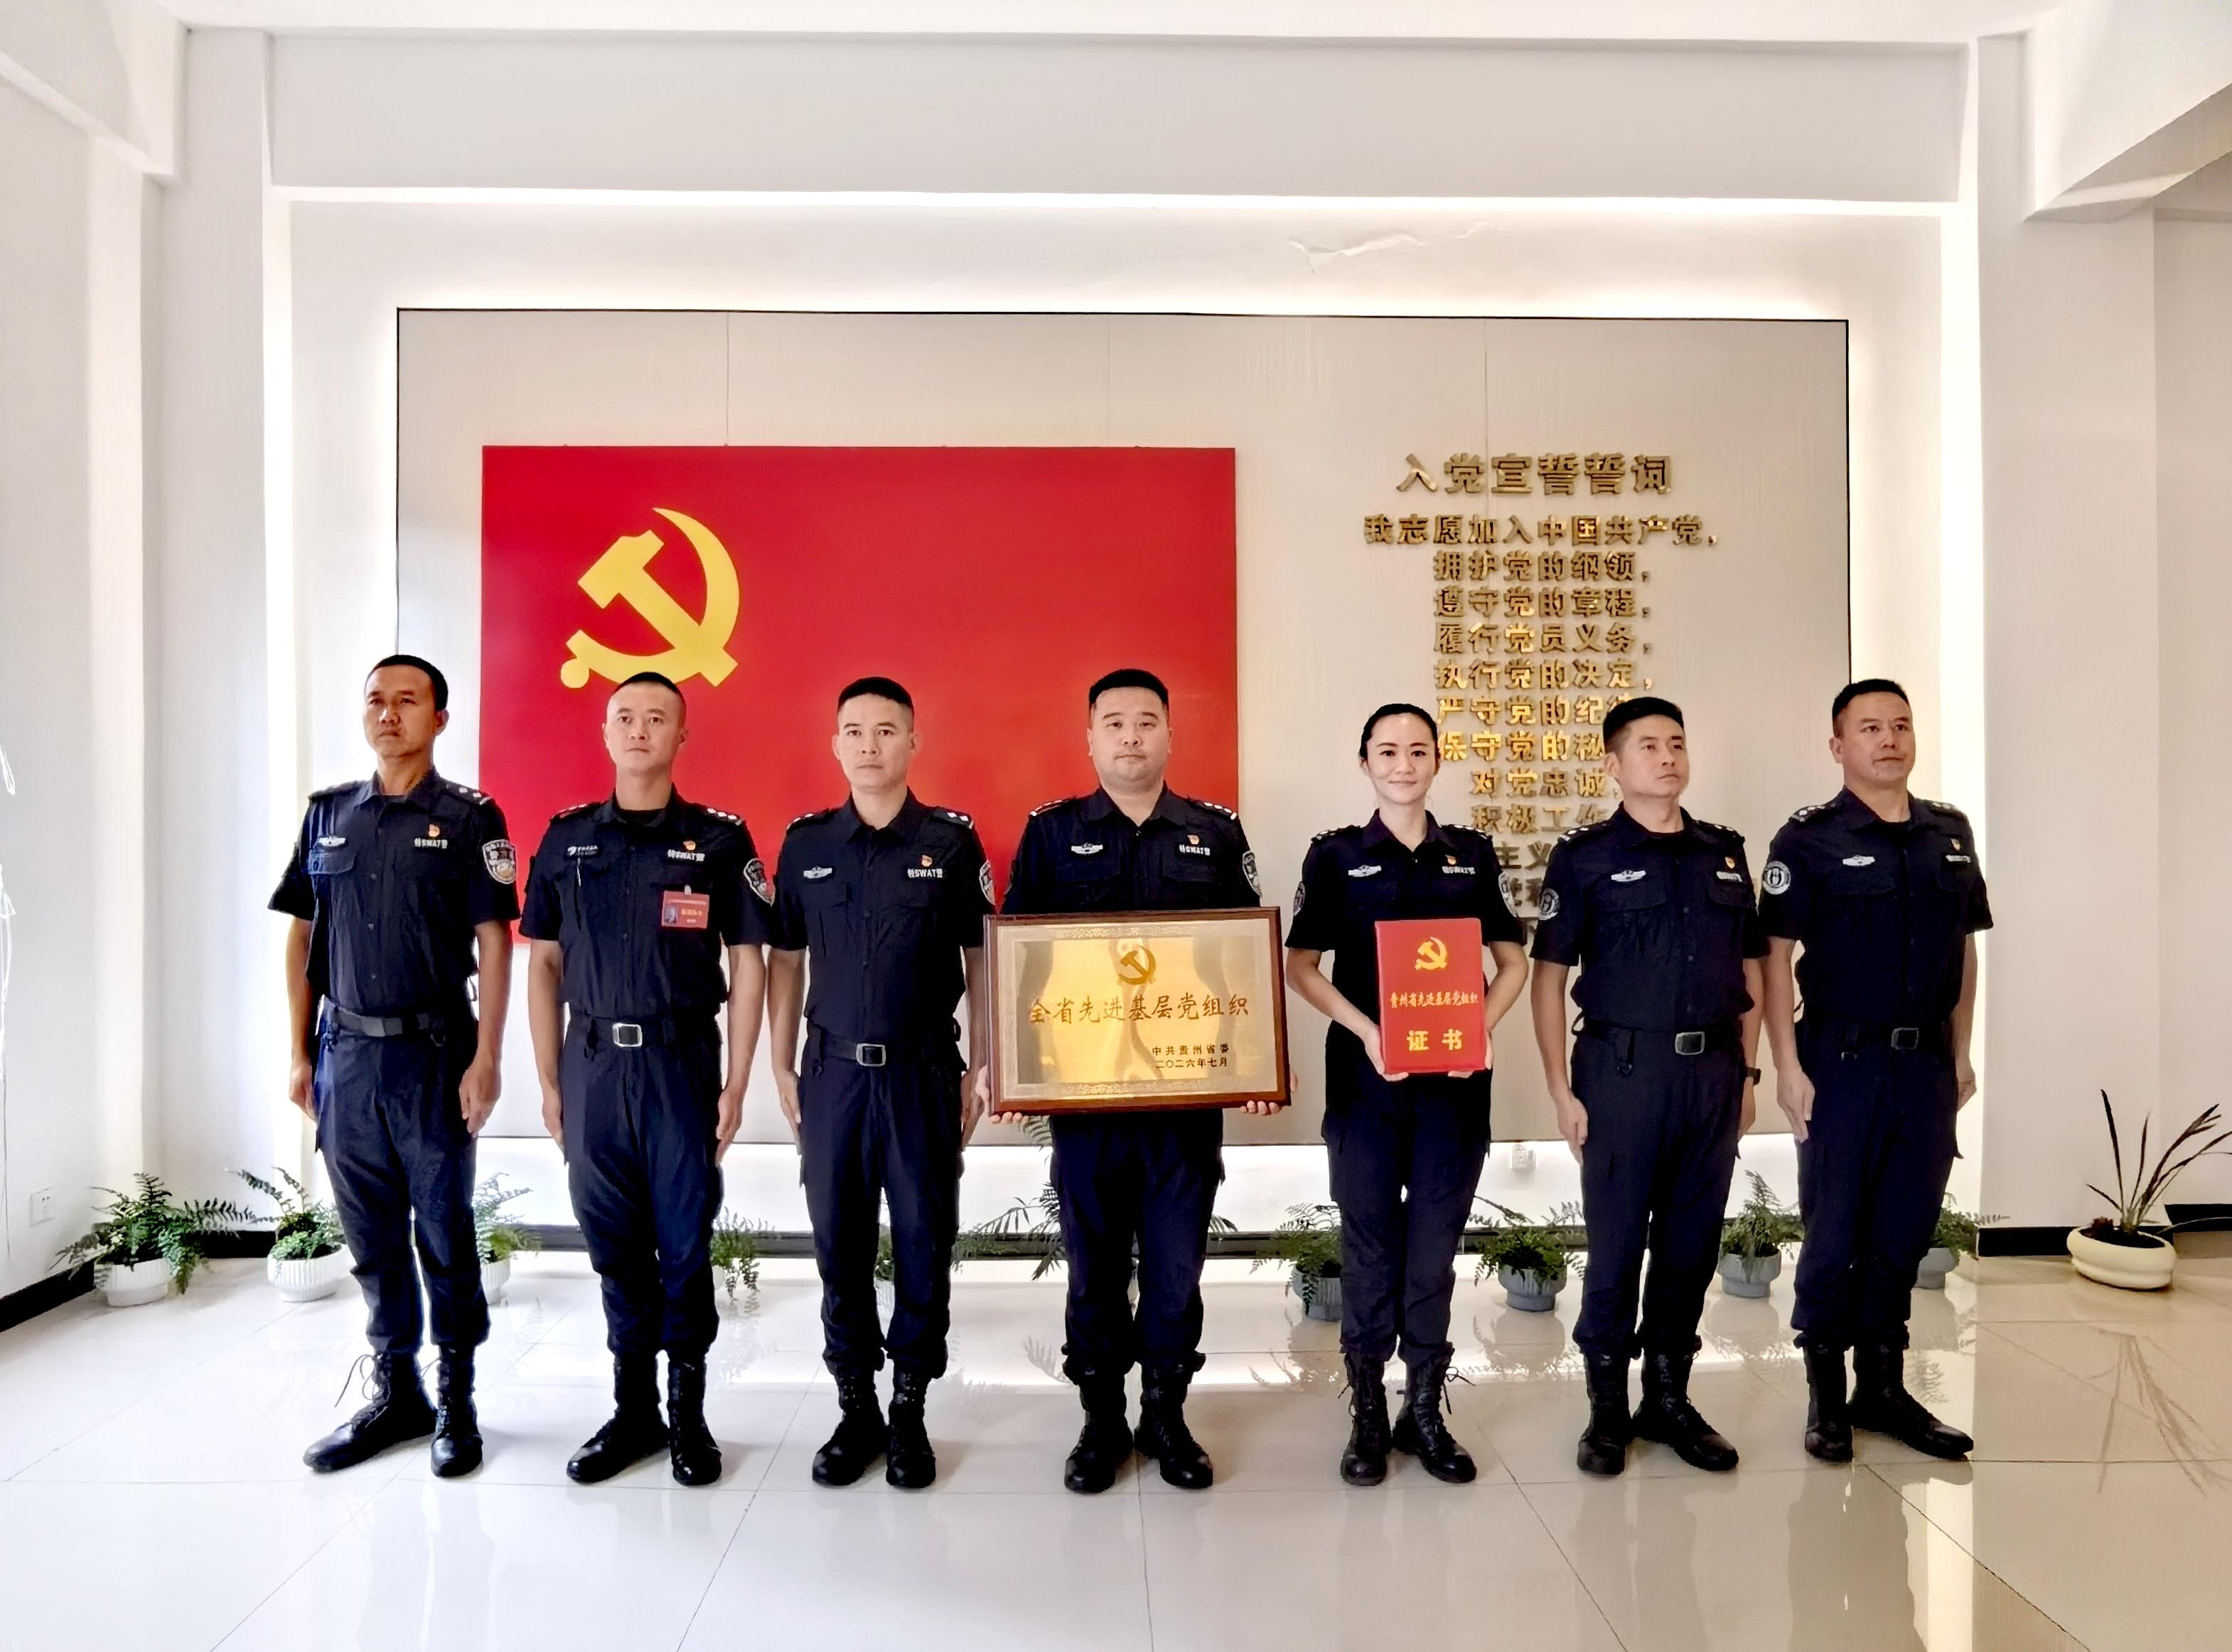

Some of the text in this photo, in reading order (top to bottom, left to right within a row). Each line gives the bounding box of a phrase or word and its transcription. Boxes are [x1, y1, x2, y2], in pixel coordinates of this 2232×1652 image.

[1395, 452, 1672, 495] 入党宣誓誓词
[1436, 692, 1633, 725] 严守党的纪
[1029, 992, 1250, 1024] 全省先进基层党组织
[1152, 1043, 1229, 1056] 中共贵州省委
[1406, 1029, 1463, 1051] 证书
